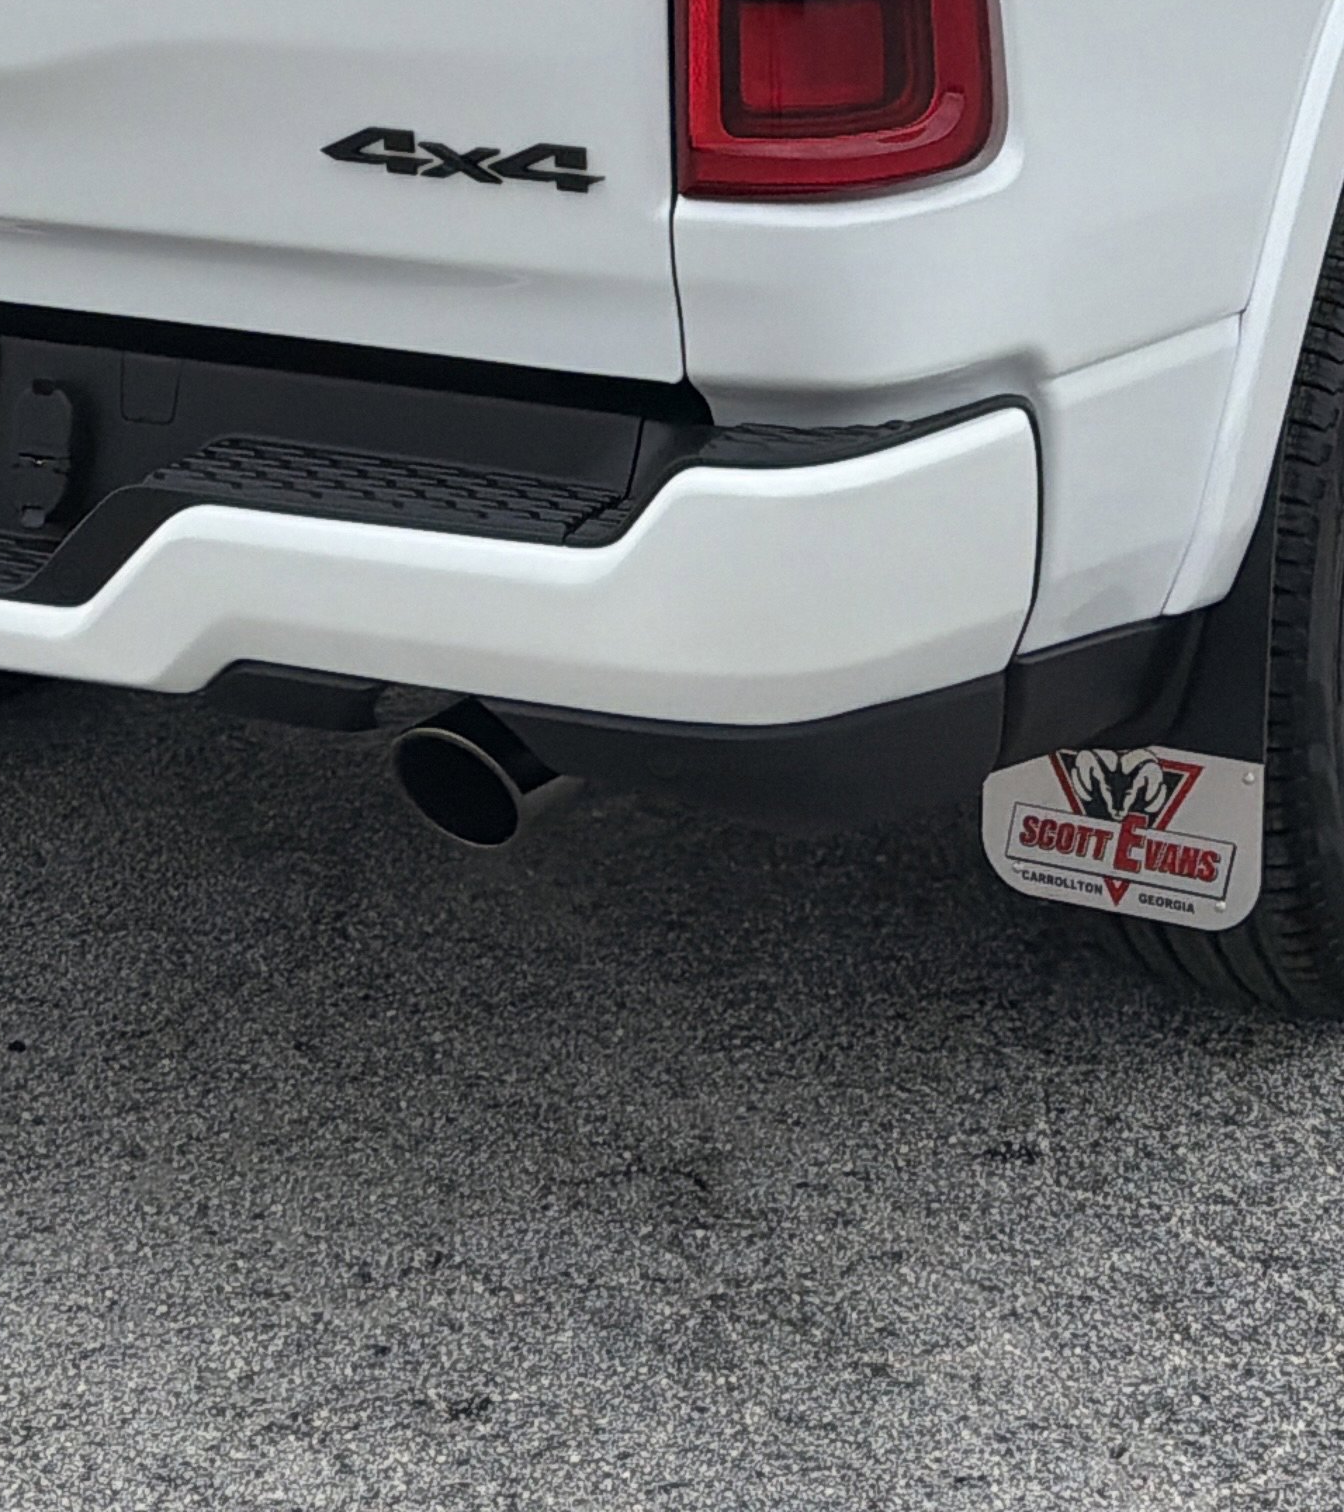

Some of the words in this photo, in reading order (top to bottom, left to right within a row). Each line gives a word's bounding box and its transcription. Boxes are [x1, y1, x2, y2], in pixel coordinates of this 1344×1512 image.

[320, 126, 605, 194] 4x4
[1019, 815, 1113, 862] SCOTT
[1113, 813, 1222, 883] EVANS
[1021, 869, 1103, 895] CARROLLTON
[1138, 892, 1196, 915] GEORGIA
